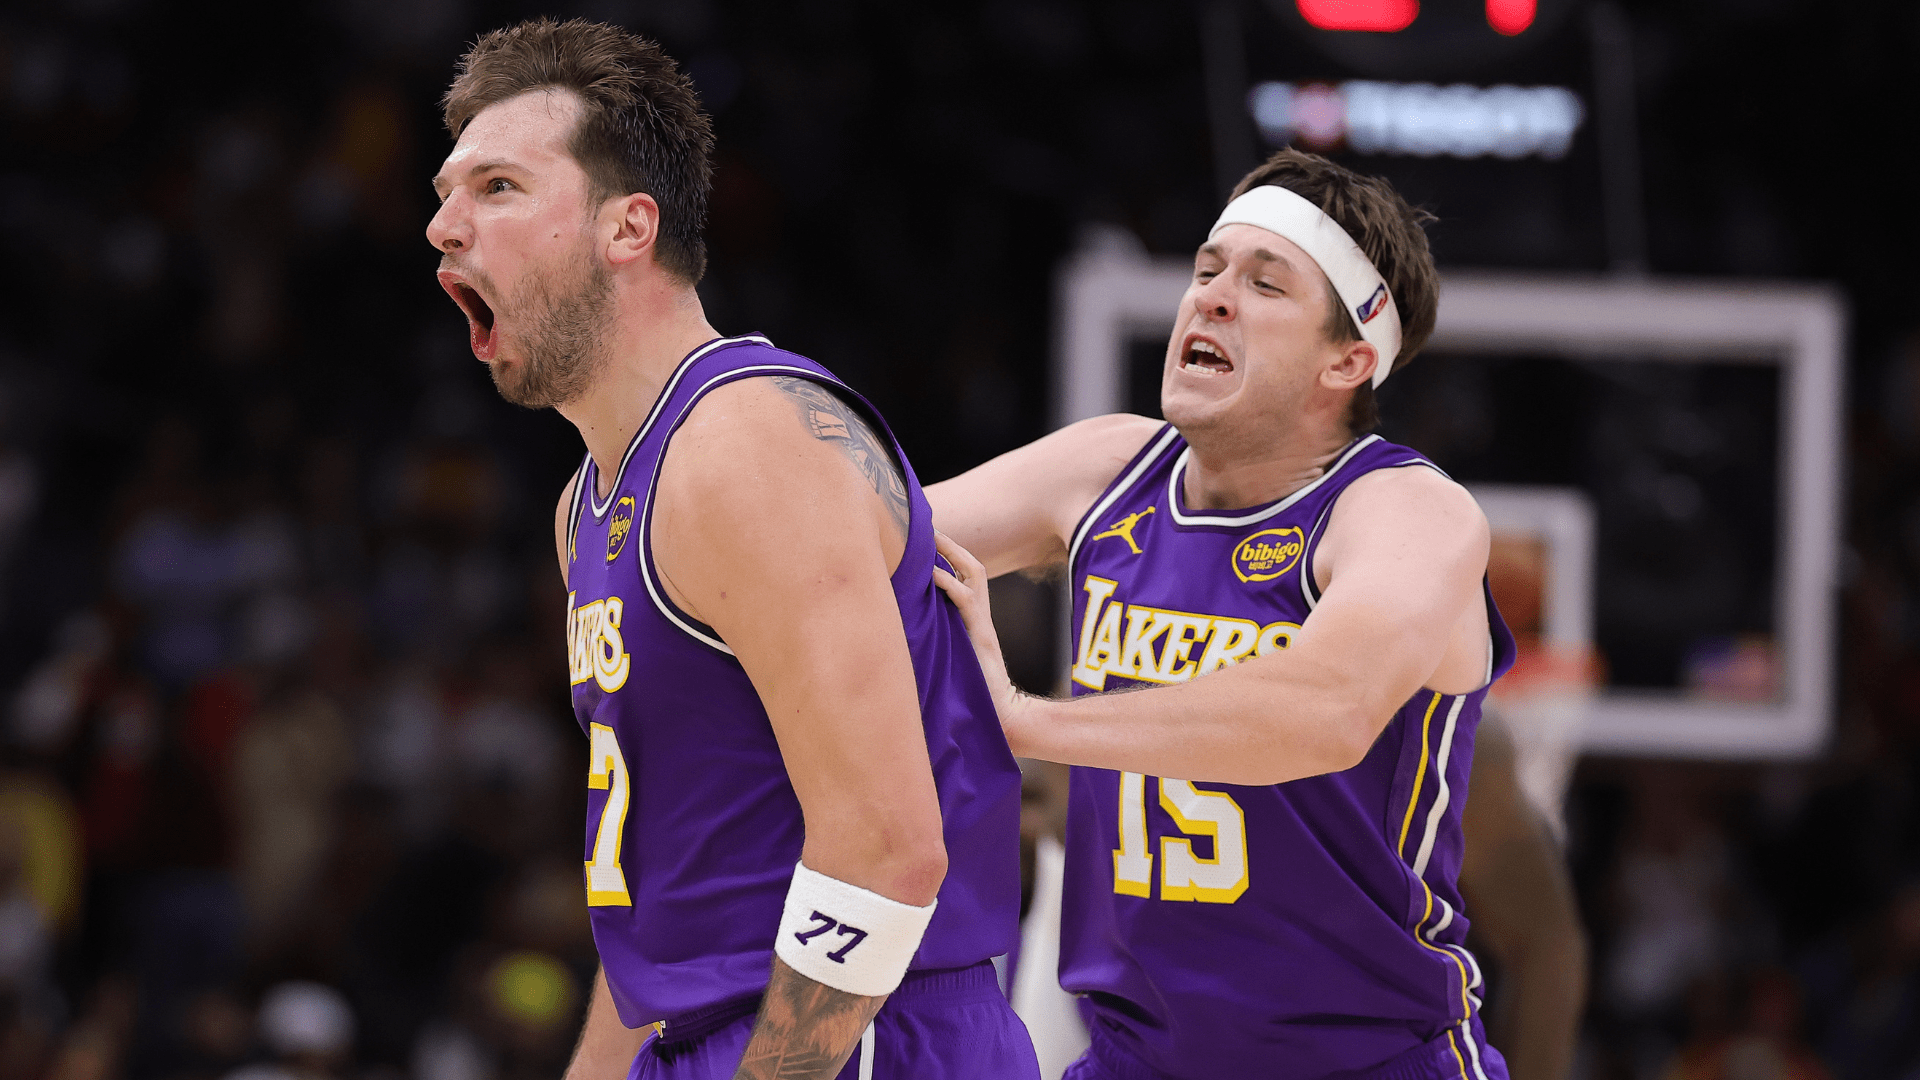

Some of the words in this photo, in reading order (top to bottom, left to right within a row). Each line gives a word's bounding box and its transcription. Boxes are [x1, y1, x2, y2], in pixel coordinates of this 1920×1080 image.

[1240, 542, 1300, 564] bibigo
[1112, 771, 1249, 904] 15
[794, 910, 868, 964] 77
